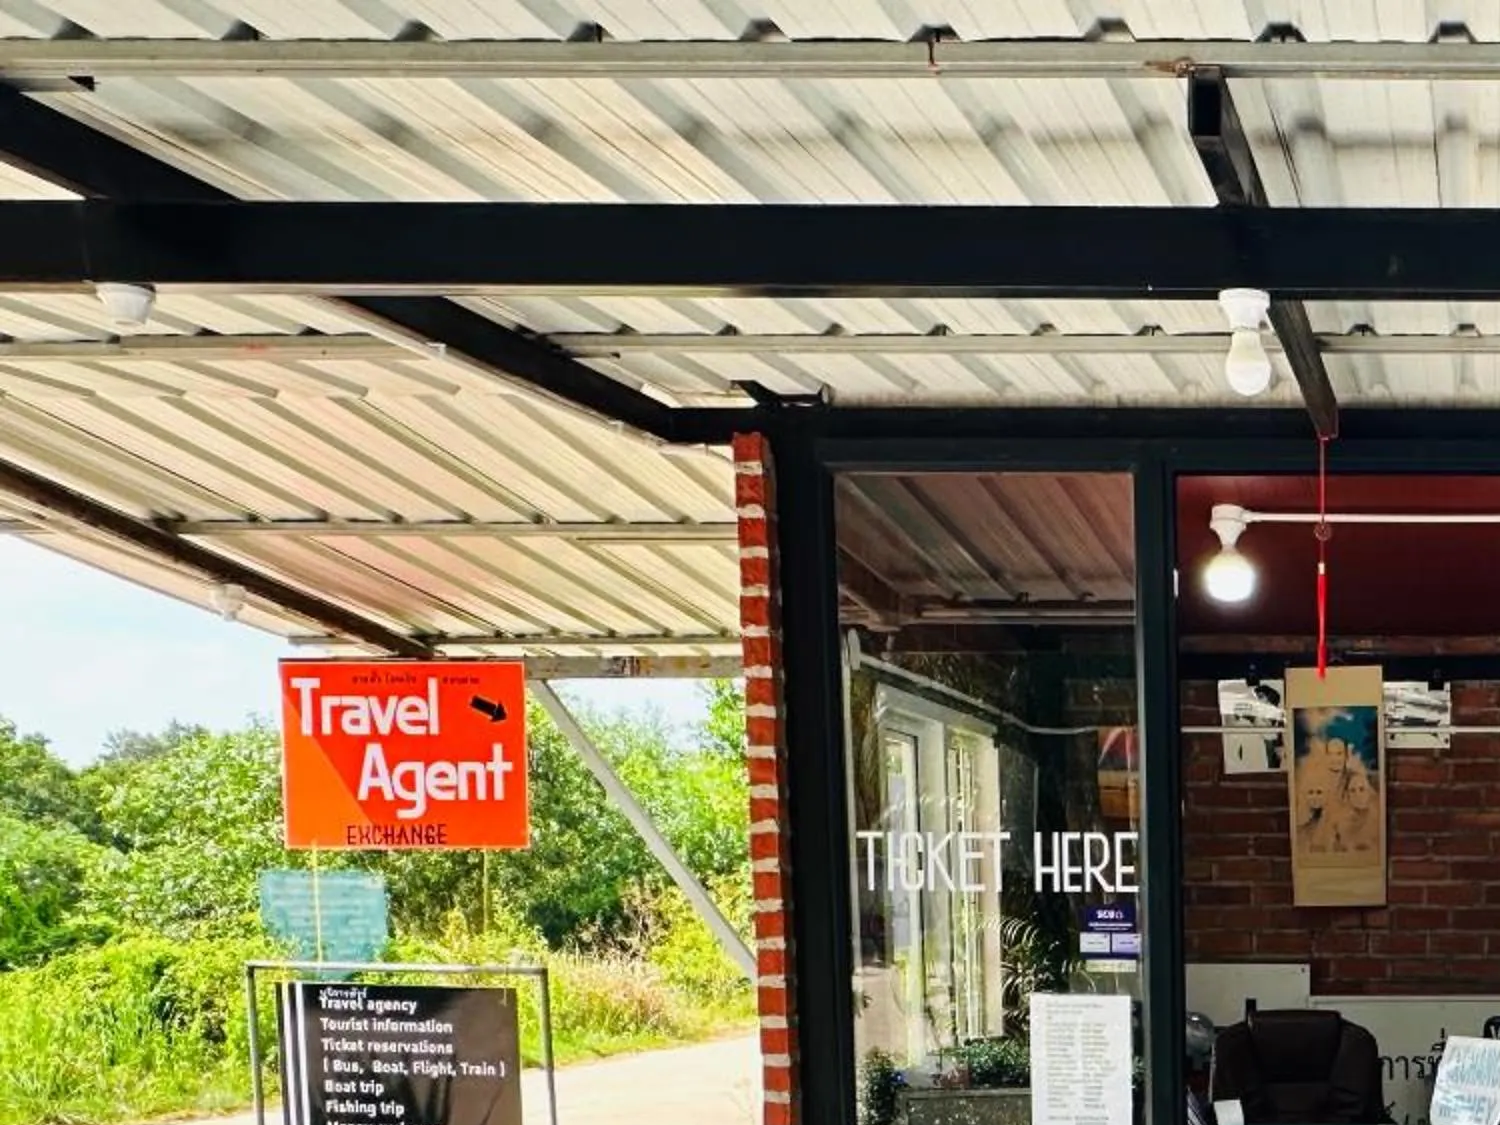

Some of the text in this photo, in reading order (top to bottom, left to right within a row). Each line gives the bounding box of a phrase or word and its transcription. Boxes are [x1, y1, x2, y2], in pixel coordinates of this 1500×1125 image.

[290, 677, 440, 736] Travel
[357, 743, 513, 819] Agent
[347, 823, 447, 845] EXCHANGE
[856, 831, 1140, 893] TICKET HERE
[319, 996, 417, 1014] Travel agency
[320, 1018, 454, 1033] Tourist information
[320, 1038, 454, 1054] Ticket reservations
[372, 1060, 408, 1075] Boat,
[413, 1061, 457, 1078] Flight,
[460, 1062, 497, 1076] Train
[324, 1080, 385, 1097] Boat trip
[325, 1100, 405, 1118] Fishing trip
